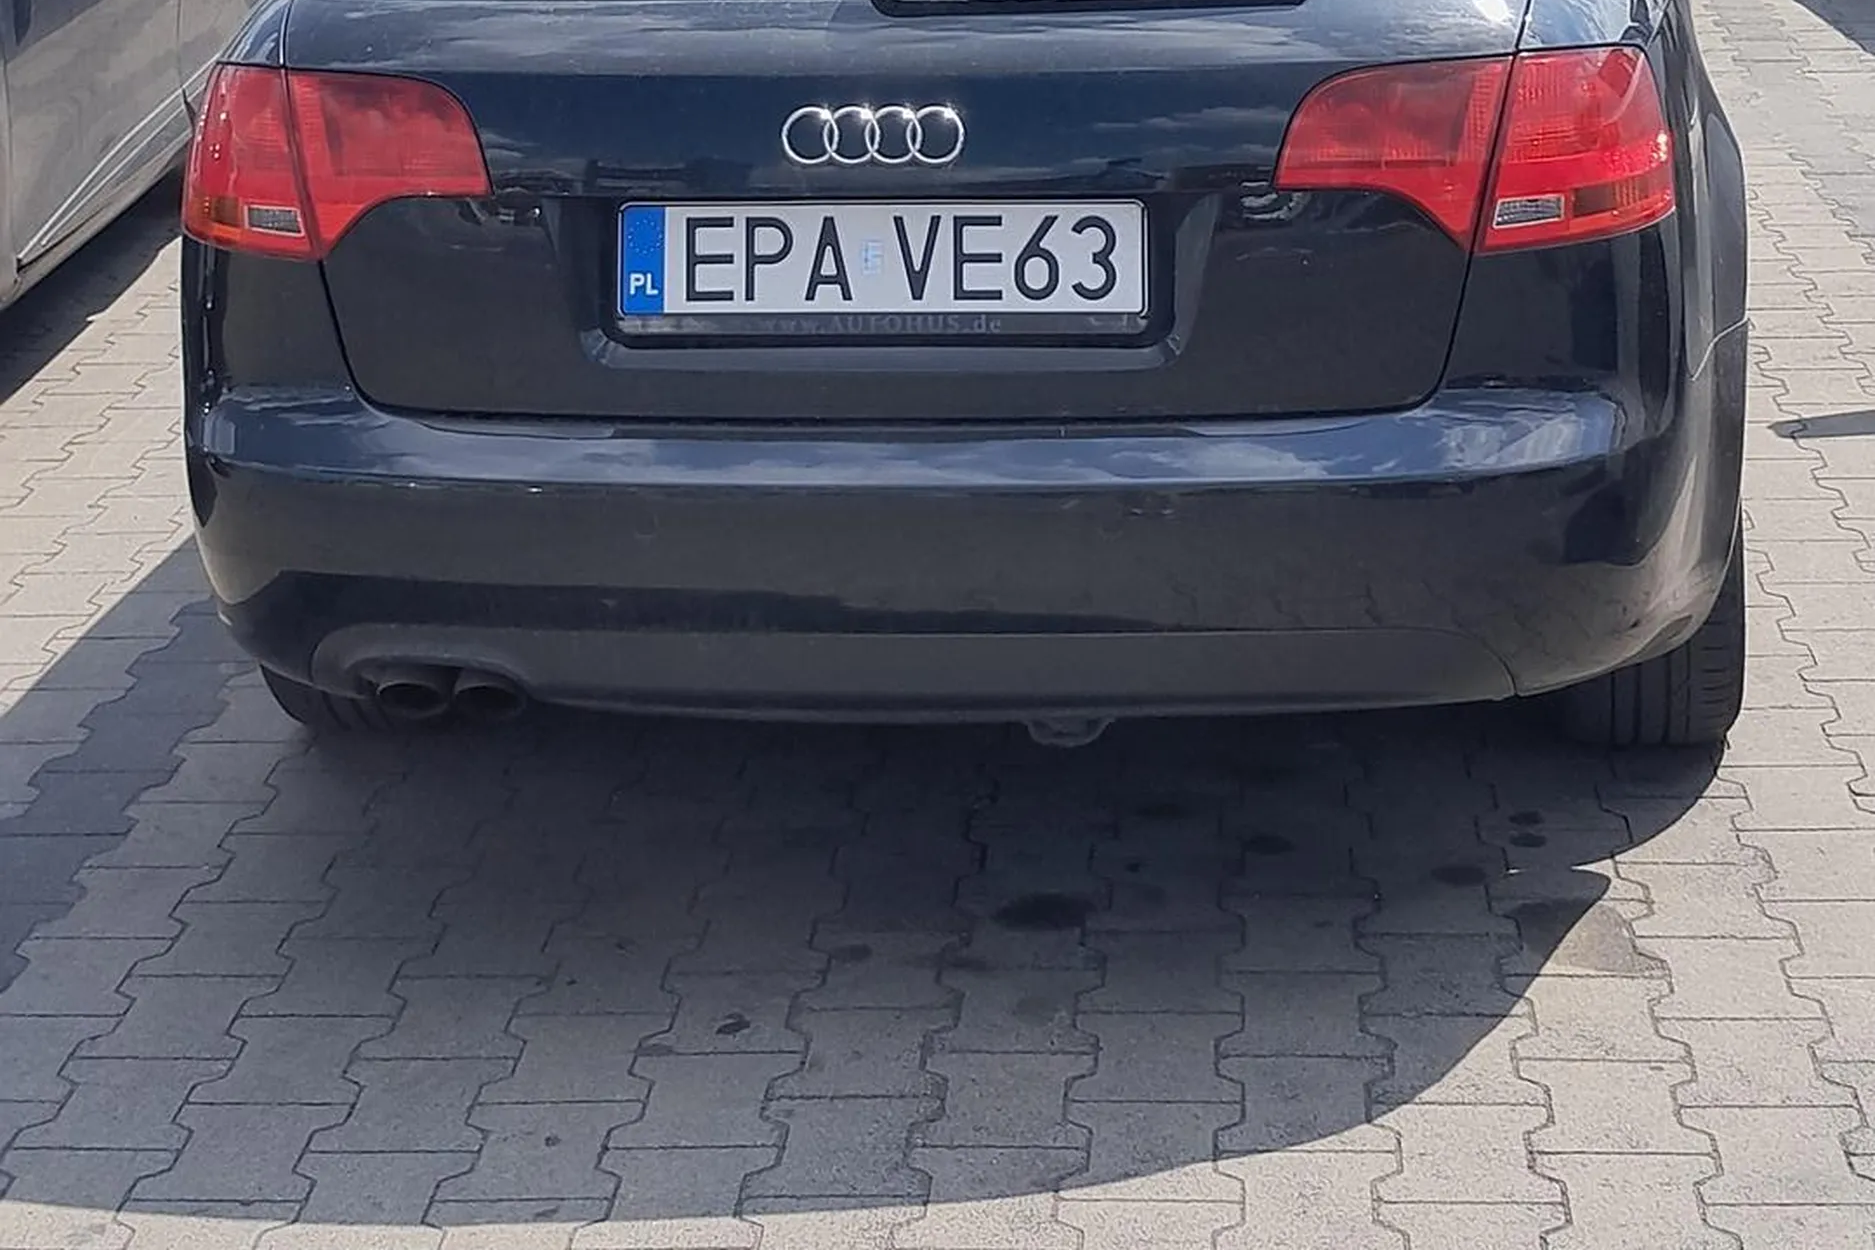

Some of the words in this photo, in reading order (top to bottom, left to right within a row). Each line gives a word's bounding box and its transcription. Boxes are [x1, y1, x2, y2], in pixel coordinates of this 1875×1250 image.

[629, 272, 659, 295] PL
[685, 214, 853, 302] EPA
[893, 214, 1118, 301] VE63
